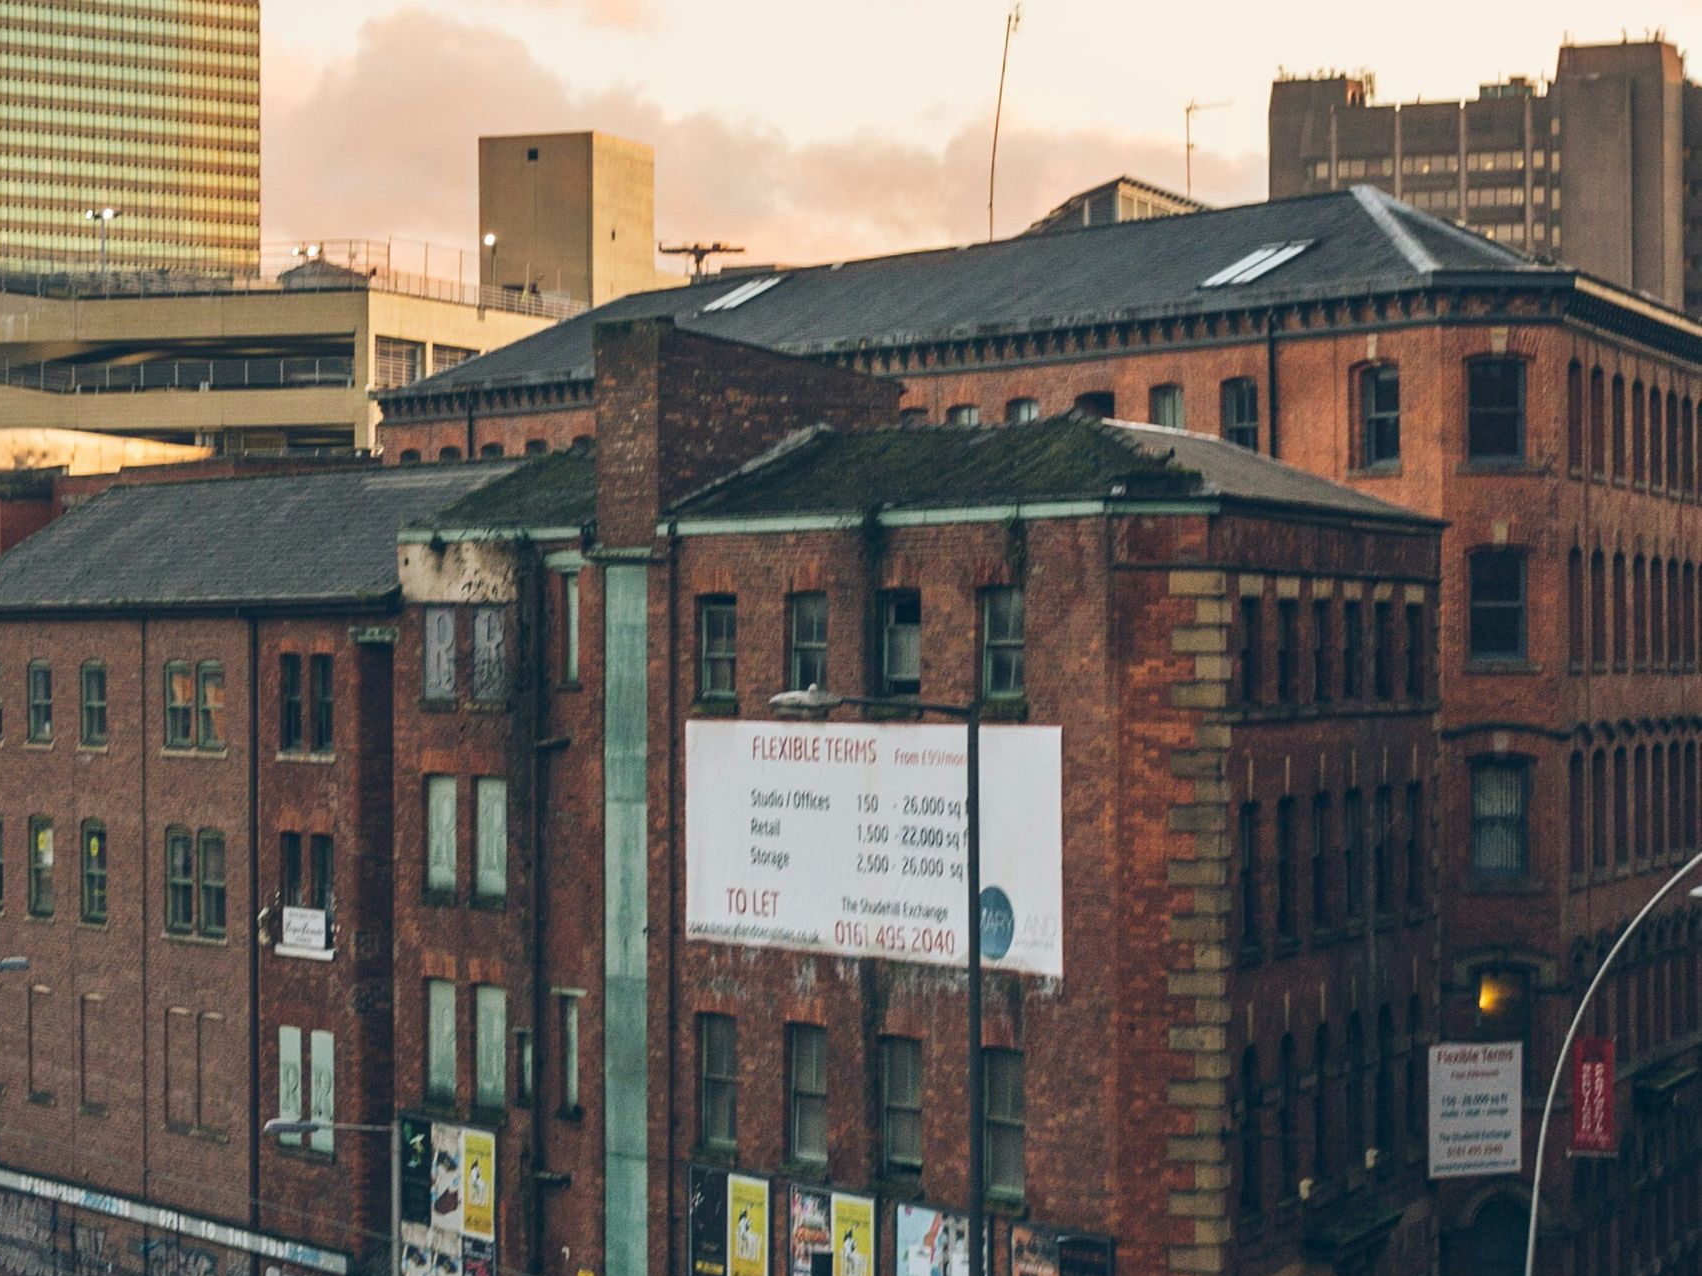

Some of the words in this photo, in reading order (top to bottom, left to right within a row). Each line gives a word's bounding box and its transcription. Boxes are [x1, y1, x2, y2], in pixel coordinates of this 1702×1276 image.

[752, 735, 820, 763] FLEXIBLE
[825, 737, 878, 766] TERMS
[894, 749, 920, 766] From
[750, 788, 784, 810] Studio
[793, 790, 831, 812] Offices
[857, 794, 879, 814] 150
[902, 795, 945, 817] 26,000
[948, 801, 962, 822] sq
[750, 817, 781, 837] Retail
[857, 824, 889, 844] 1,500
[902, 825, 944, 848] 22,000
[946, 831, 960, 852] sq
[750, 846, 790, 871] Storage
[857, 854, 889, 875] 2,500
[901, 855, 945, 878] 26,000
[950, 862, 964, 882] sq
[726, 887, 747, 915] TO
[752, 889, 781, 918] LET
[841, 896, 859, 913] The
[902, 901, 949, 923] Exchange
[834, 919, 869, 949] 0161
[875, 923, 906, 951] 495
[911, 926, 956, 956] 2040
[1437, 1048, 1479, 1064] Flexible
[1482, 1046, 1514, 1062] Terms
[201, 1219, 216, 1240] TO
